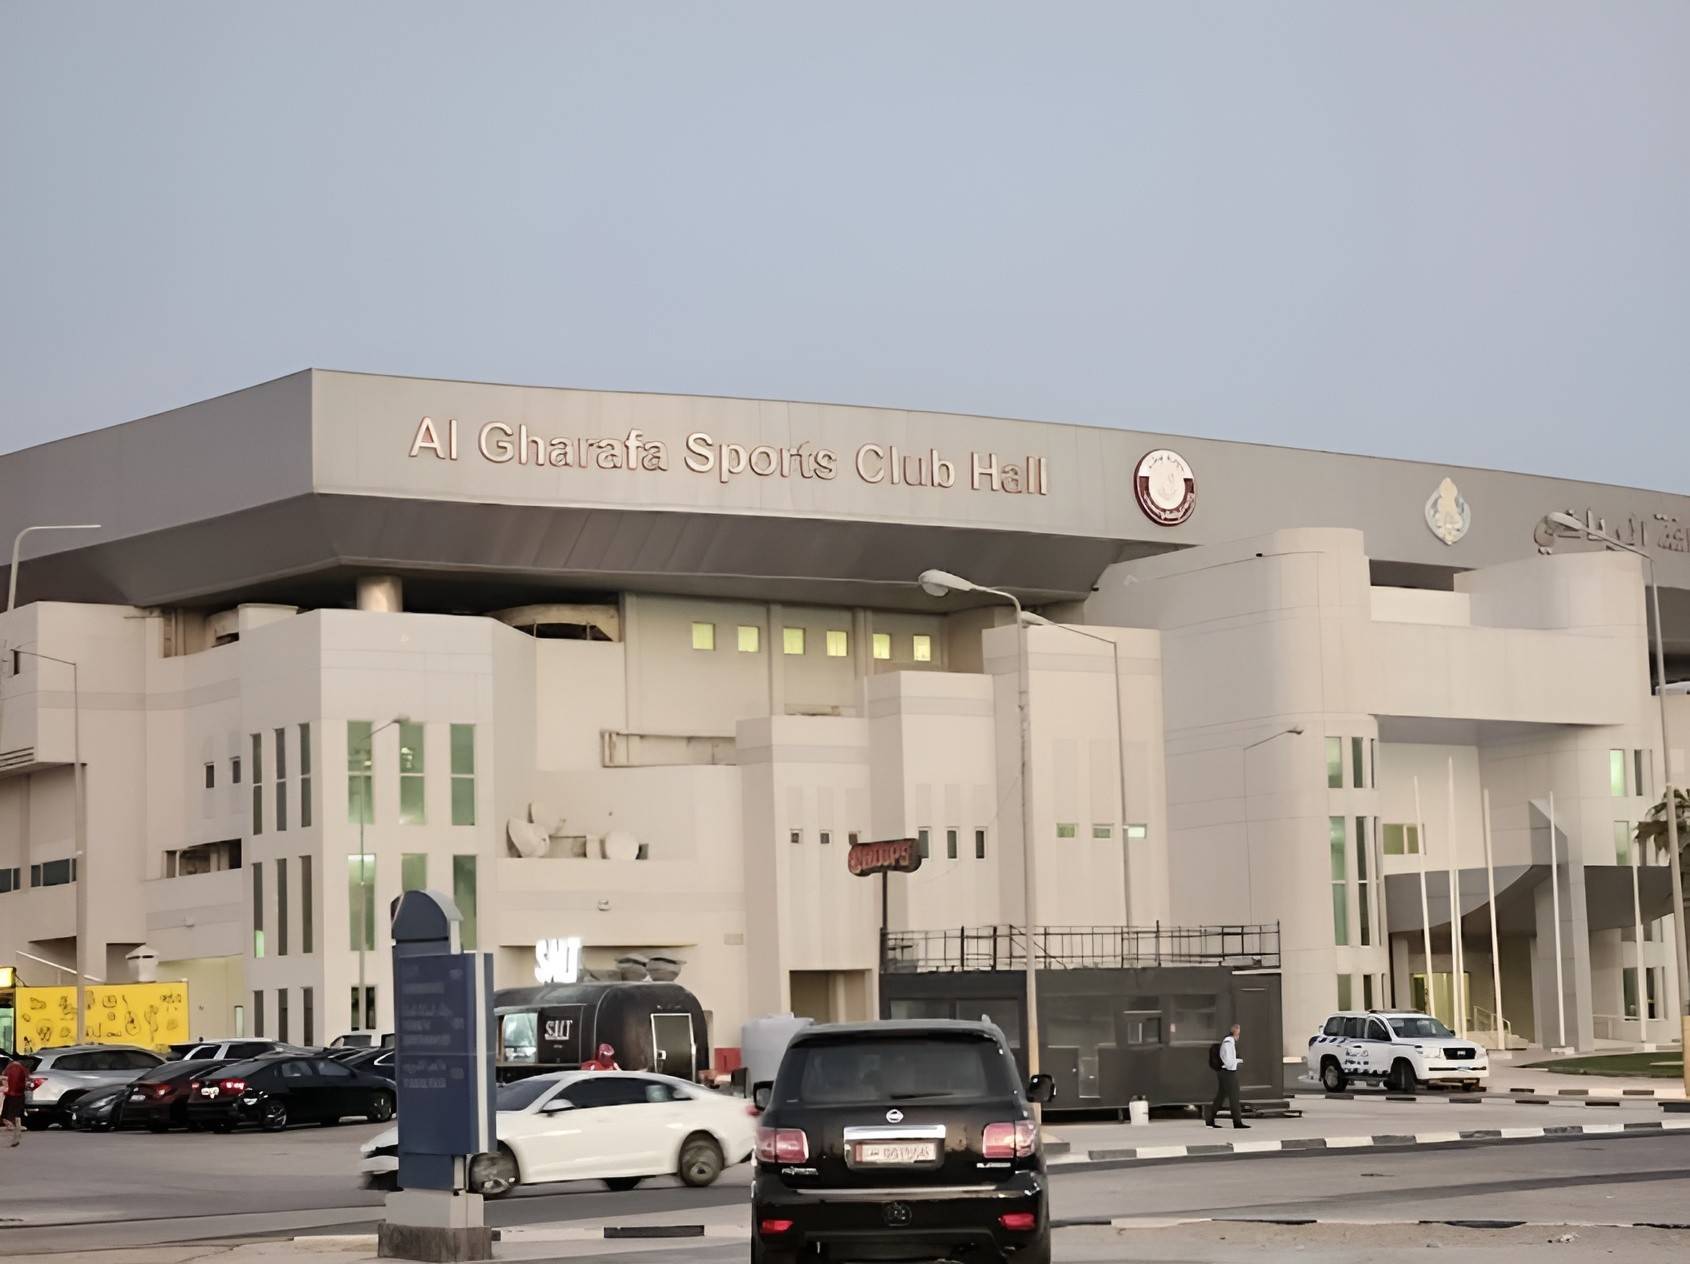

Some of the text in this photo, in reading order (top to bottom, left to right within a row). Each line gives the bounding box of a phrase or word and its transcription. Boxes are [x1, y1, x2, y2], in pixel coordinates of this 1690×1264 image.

[409, 416, 1048, 496] Al Gharafa Sports Club Hall
